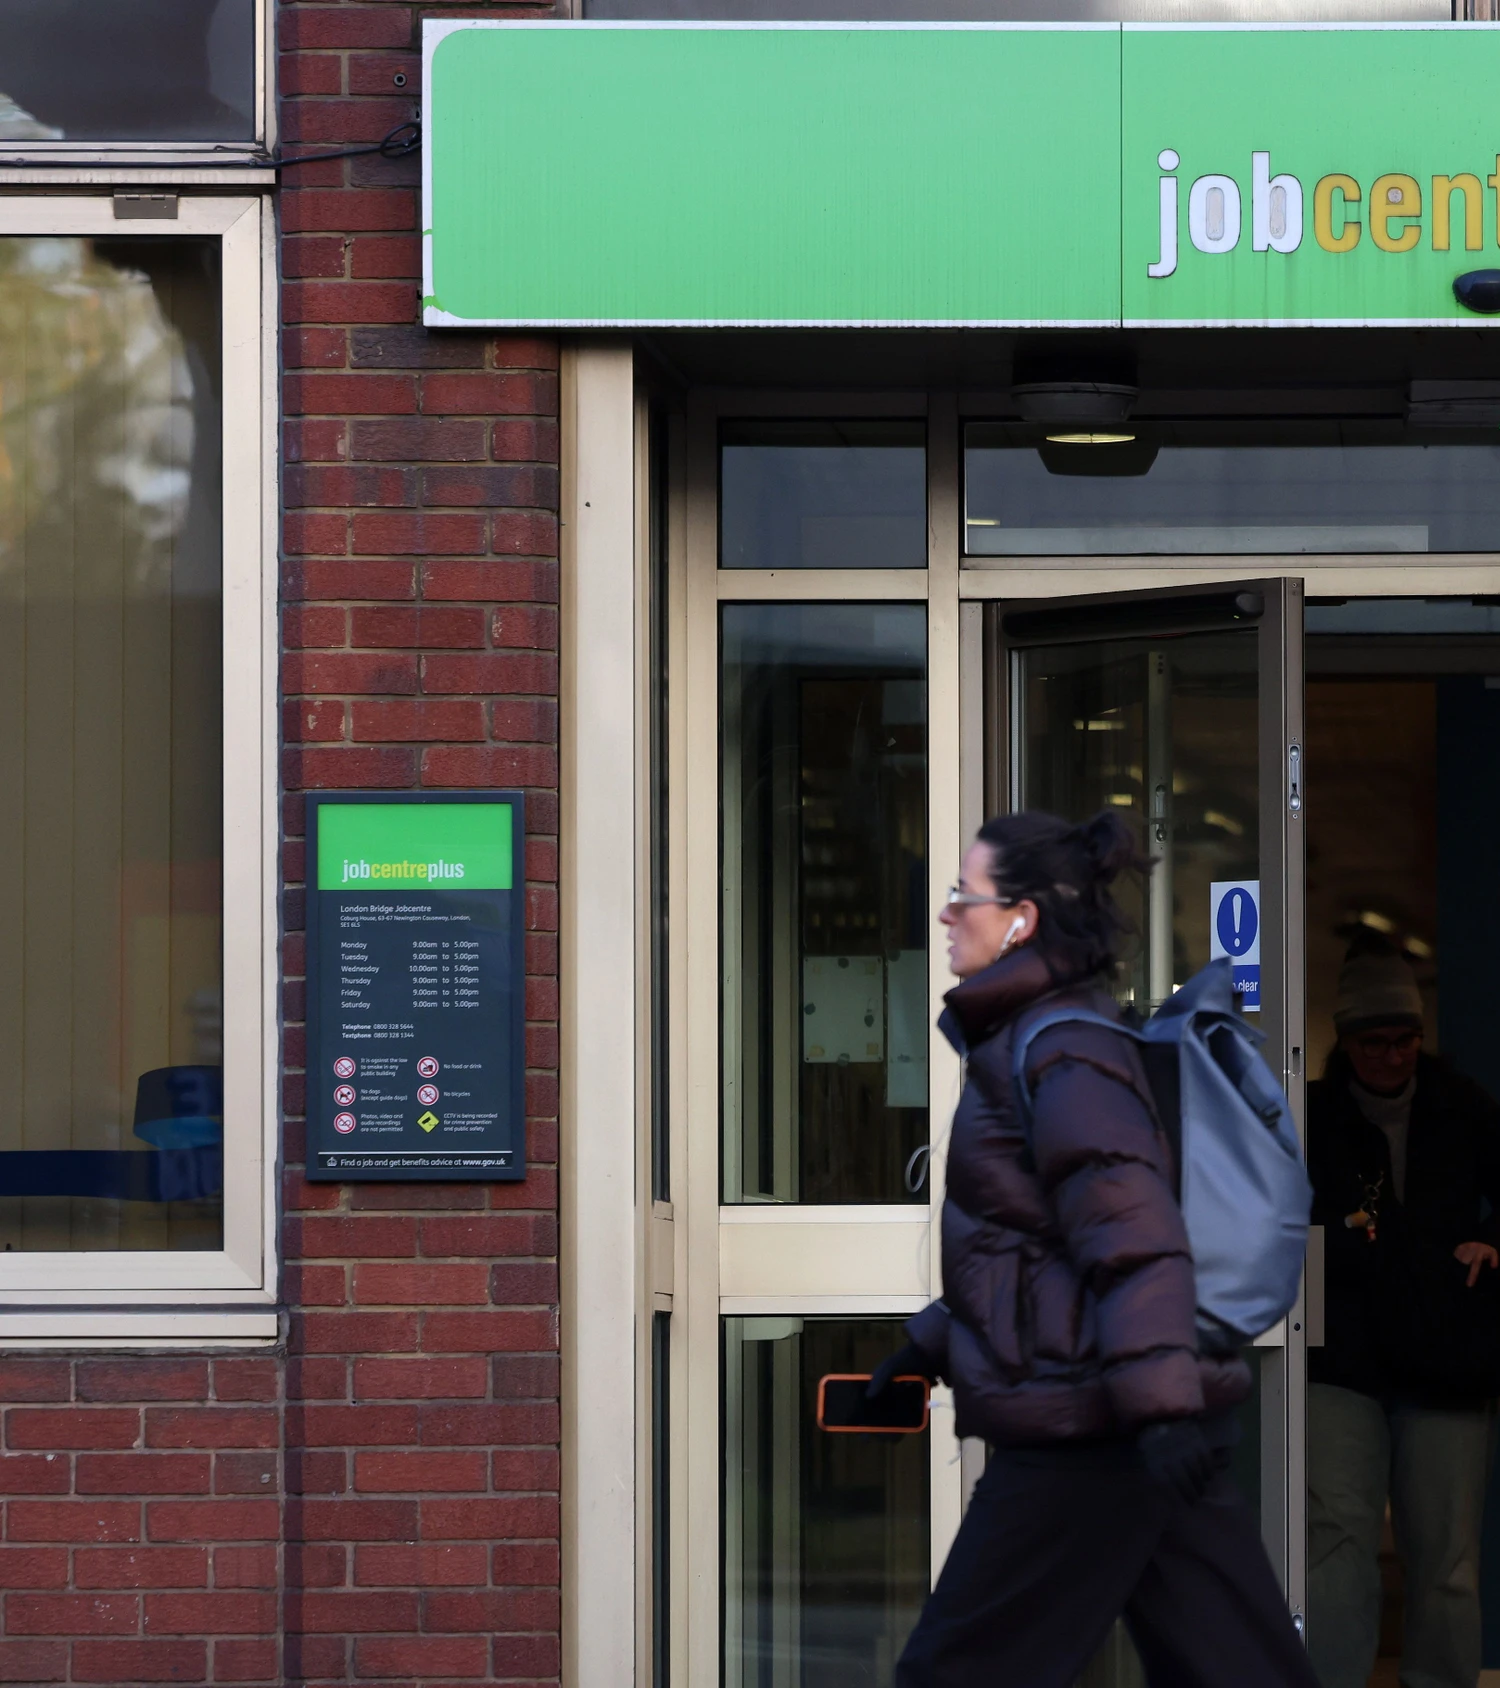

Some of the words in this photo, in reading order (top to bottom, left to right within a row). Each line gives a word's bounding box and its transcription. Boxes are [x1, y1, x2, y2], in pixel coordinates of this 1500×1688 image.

[342, 859, 465, 882] jobcentreplus
[340, 905, 368, 913] London
[369, 905, 394, 914] Bridge
[395, 905, 432, 913] Jobcentre
[341, 941, 367, 949] Monday
[453, 941, 479, 949] 5.00pm
[341, 953, 368, 961] Tuesday
[453, 953, 479, 961] 5.00pm
[341, 965, 380, 973] Wednesday
[453, 965, 479, 973] 5.00pm
[341, 977, 371, 985] Thursday
[453, 977, 479, 985] 5.00pm
[1238, 979, 1258, 992] clear
[341, 989, 362, 997] Friday
[453, 989, 479, 997] 5.00pm
[341, 1001, 371, 1009] Saturday
[453, 1001, 479, 1009] 5.00pm
[342, 1023, 371, 1031] Telephone
[340, 1158, 355, 1166] Find
[362, 1158, 373, 1167] job
[374, 1158, 388, 1166] and
[389, 1159, 401, 1168] get
[401, 1158, 430, 1166] benefits
[430, 1158, 453, 1166] advice
[462, 1158, 506, 1168] www.gov.uk
